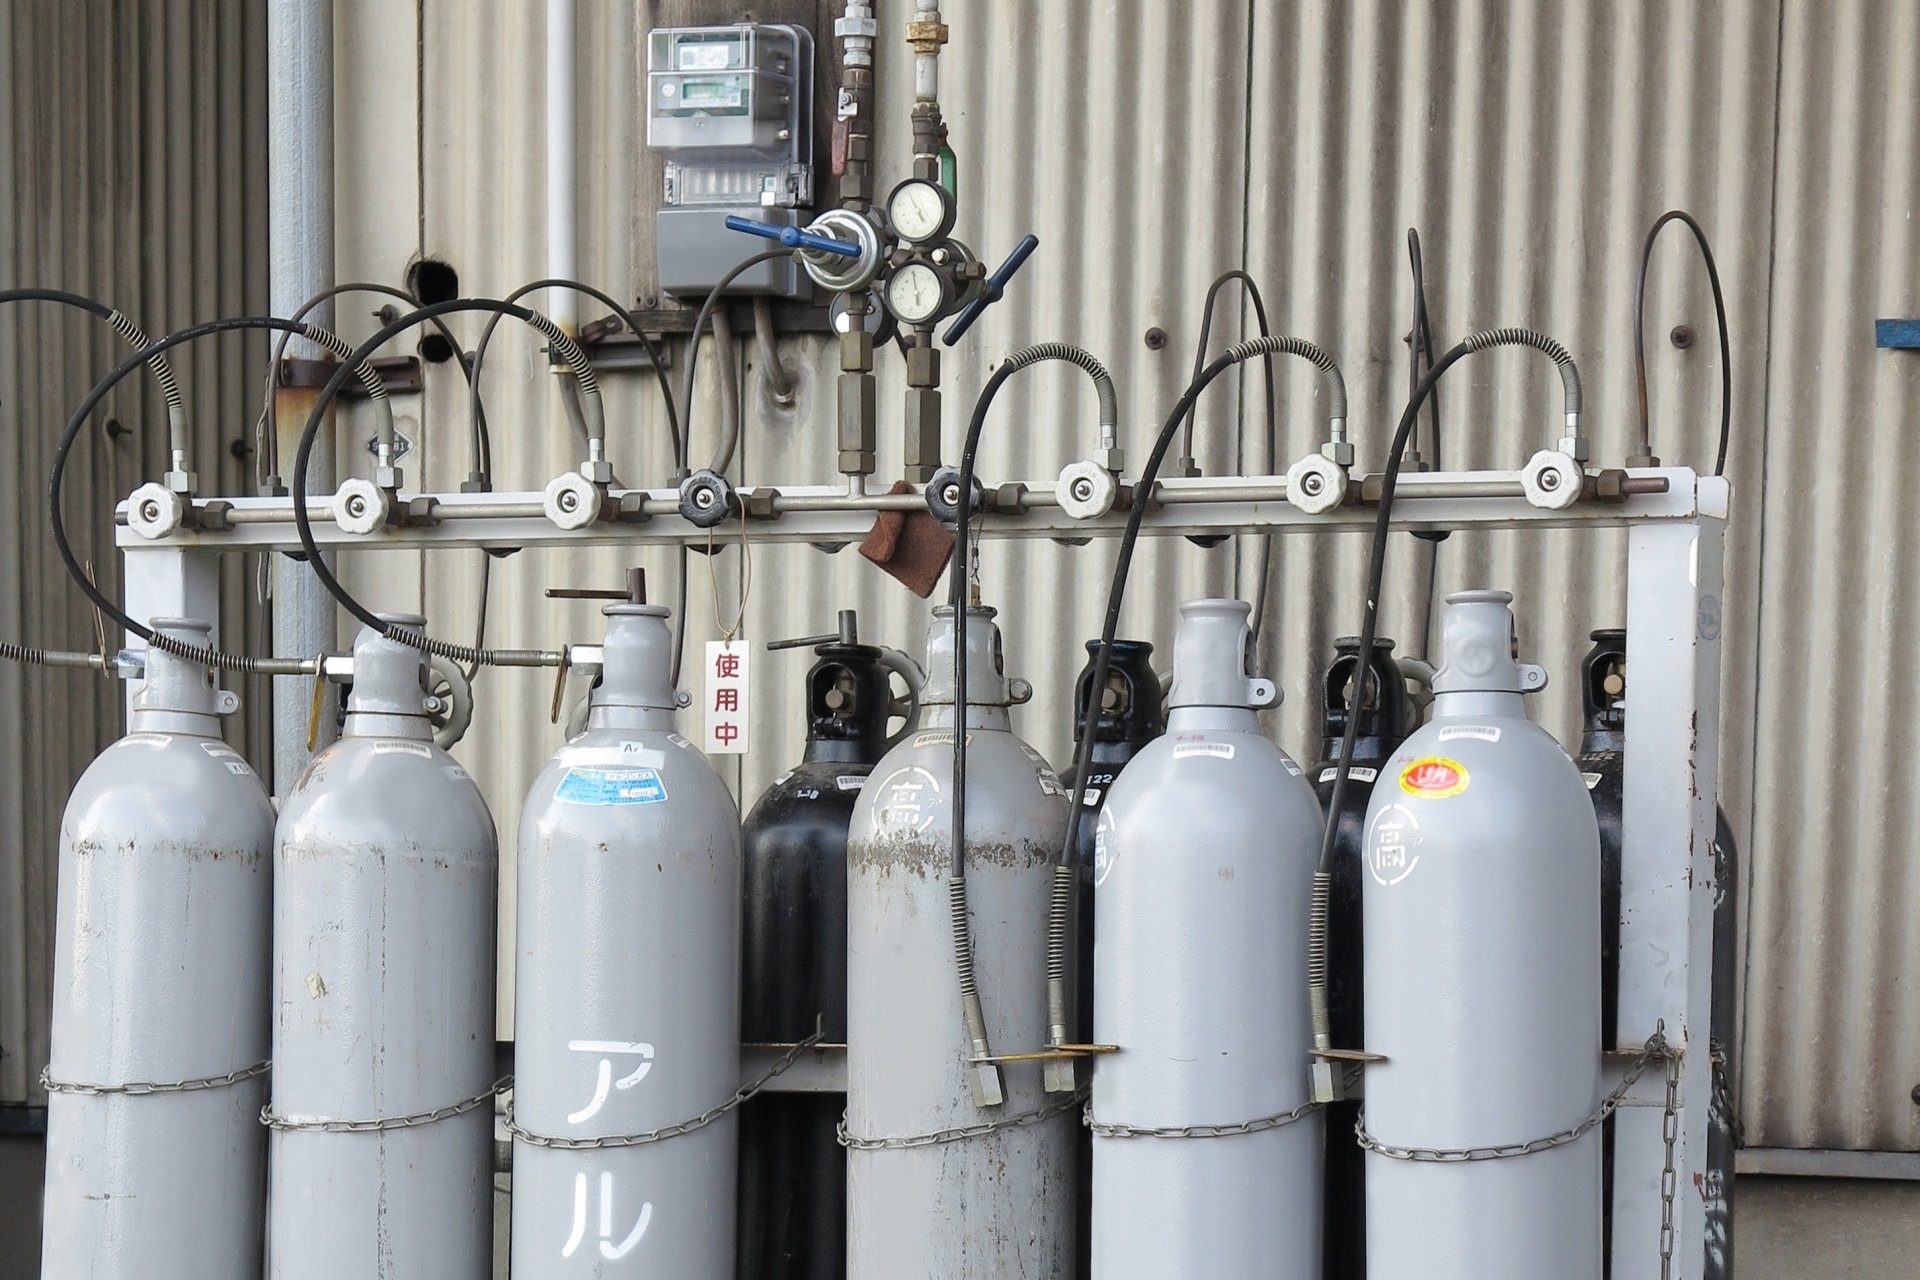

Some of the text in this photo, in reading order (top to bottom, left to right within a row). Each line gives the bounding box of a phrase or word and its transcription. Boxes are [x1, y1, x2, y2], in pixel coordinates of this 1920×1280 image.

[715, 653, 740, 747] 使用中
[623, 743, 639, 753] Ar
[608, 773, 651, 781] アルゴンガス
[561, 1040, 655, 1260] アル
